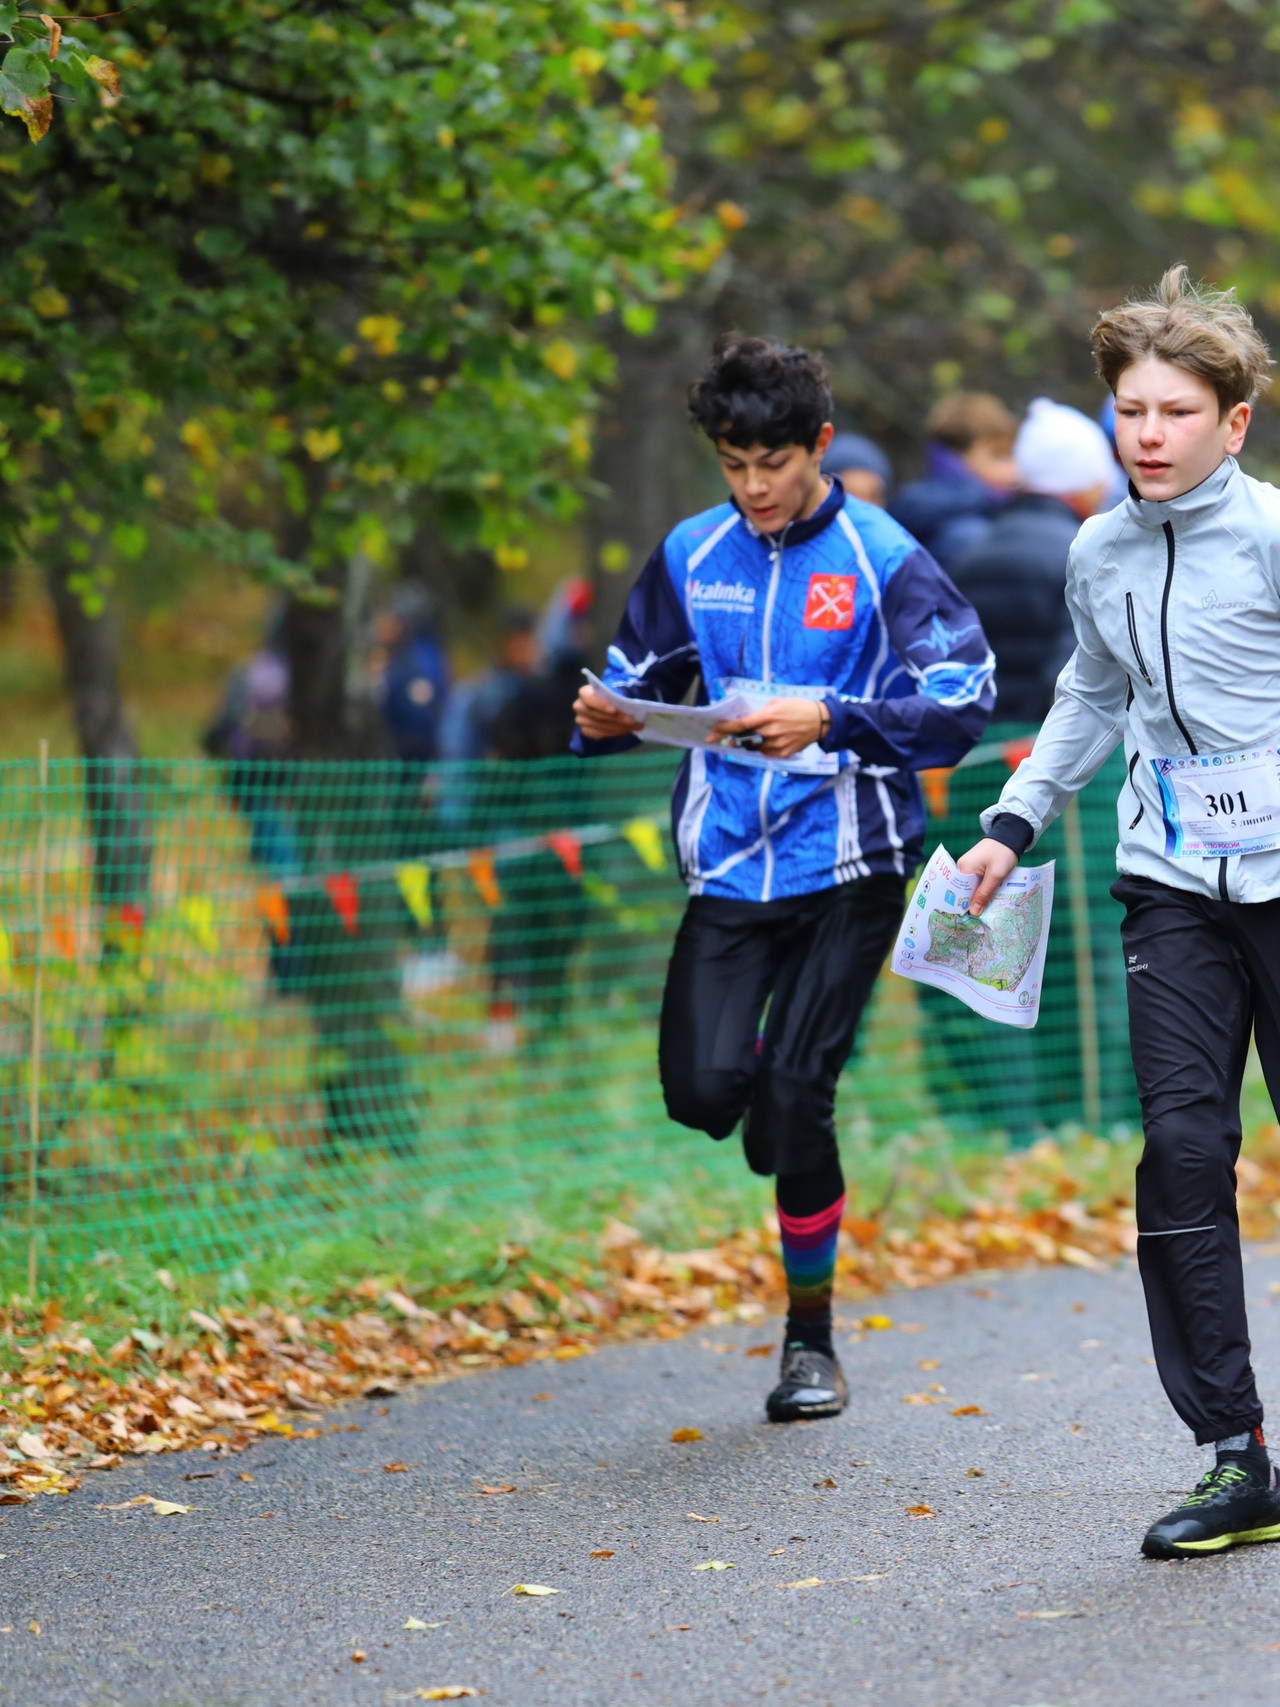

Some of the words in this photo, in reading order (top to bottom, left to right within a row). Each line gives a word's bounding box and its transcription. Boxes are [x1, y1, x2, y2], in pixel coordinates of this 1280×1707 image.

[691, 580, 756, 604] kalinka
[1210, 601, 1256, 610] NORD
[1204, 789, 1249, 818] 301
[1231, 819, 1238, 829] 5
[1218, 841, 1240, 849] РОССИИ
[935, 856, 951, 880] 301.1
